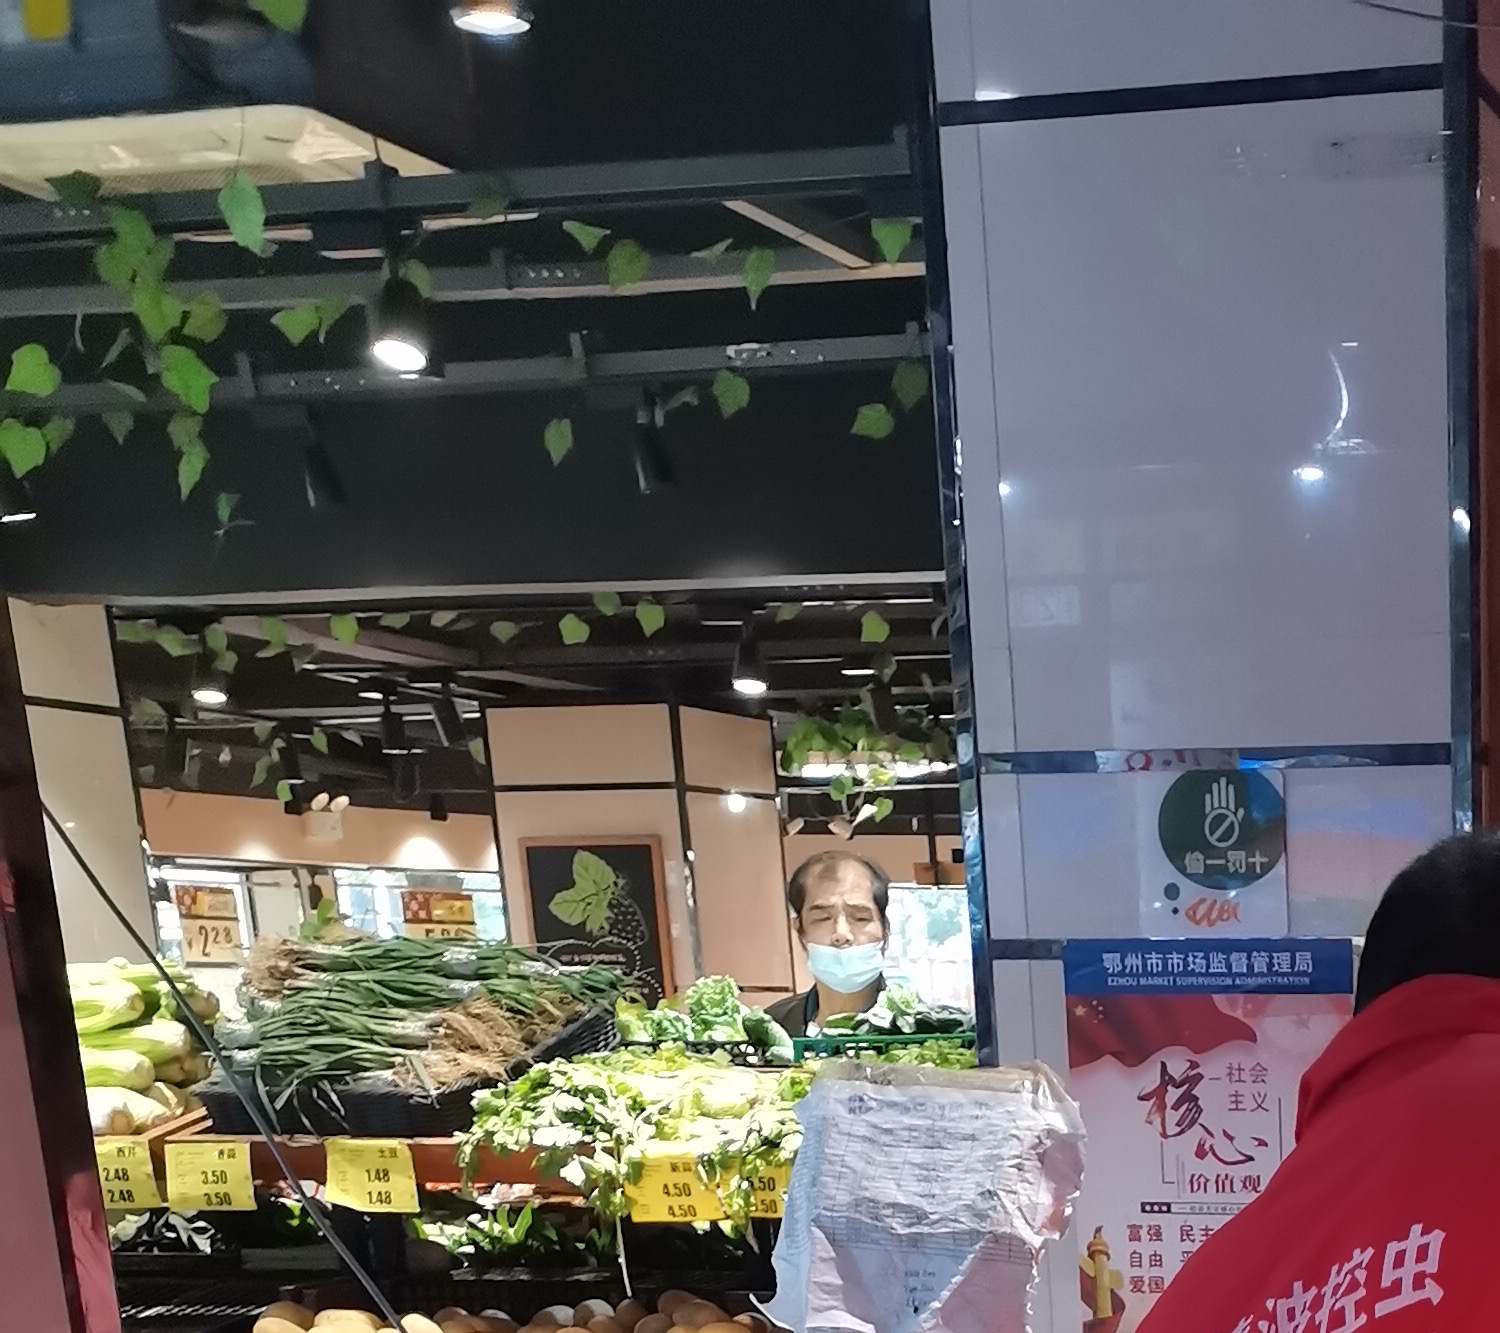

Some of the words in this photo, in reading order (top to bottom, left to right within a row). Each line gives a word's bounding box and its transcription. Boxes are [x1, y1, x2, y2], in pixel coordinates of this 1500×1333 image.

[1102, 951, 1313, 974] 鄂州市市场监督管理局
[1107, 976, 1137, 986] EZHOU
[1139, 976, 1173, 986] MARKET
[1176, 976, 1232, 987] SUPERVISION
[1234, 976, 1310, 986] ADMINISTRATION
[1226, 1062, 1268, 1085] 社会
[1228, 1090, 1269, 1113] 主义
[662, 1182, 692, 1198] 4.50
[1189, 1172, 1262, 1195] 价值观
[667, 1204, 697, 1218] 4.50
[1127, 1224, 1163, 1243] 富强
[1179, 1221, 1216, 1244] 民主
[1129, 1249, 1163, 1269] 自由
[1129, 1275, 1165, 1294] 爱国
